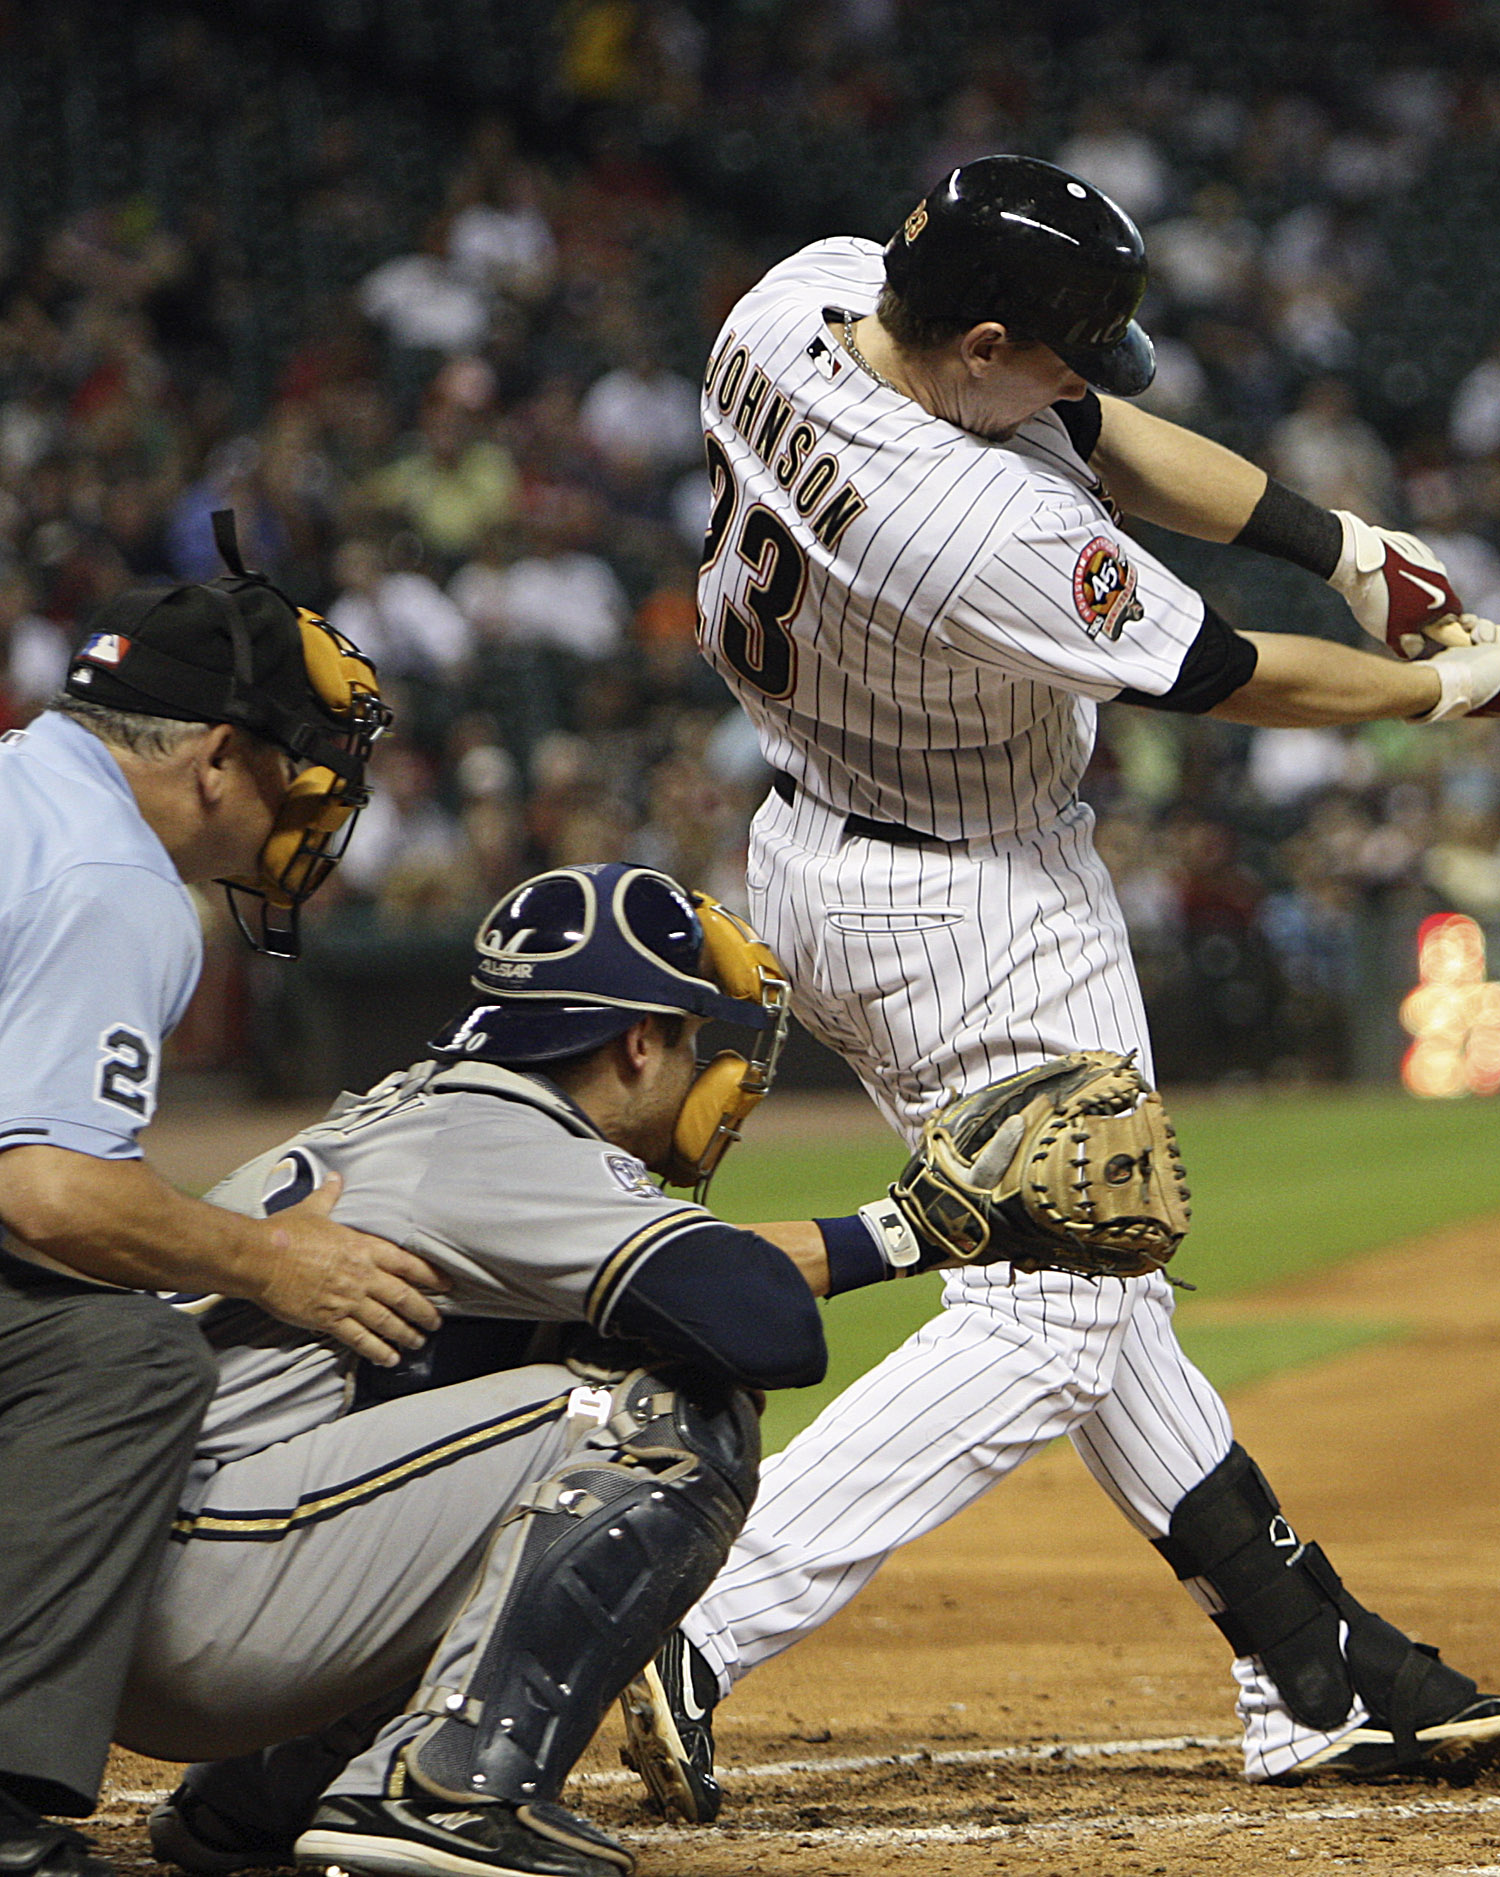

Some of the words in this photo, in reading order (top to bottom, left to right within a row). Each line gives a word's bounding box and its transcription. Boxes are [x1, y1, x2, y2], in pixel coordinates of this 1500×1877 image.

[702, 329, 868, 551] JOHNSON
[695, 430, 808, 701] 23
[94, 1022, 157, 1122] 2
